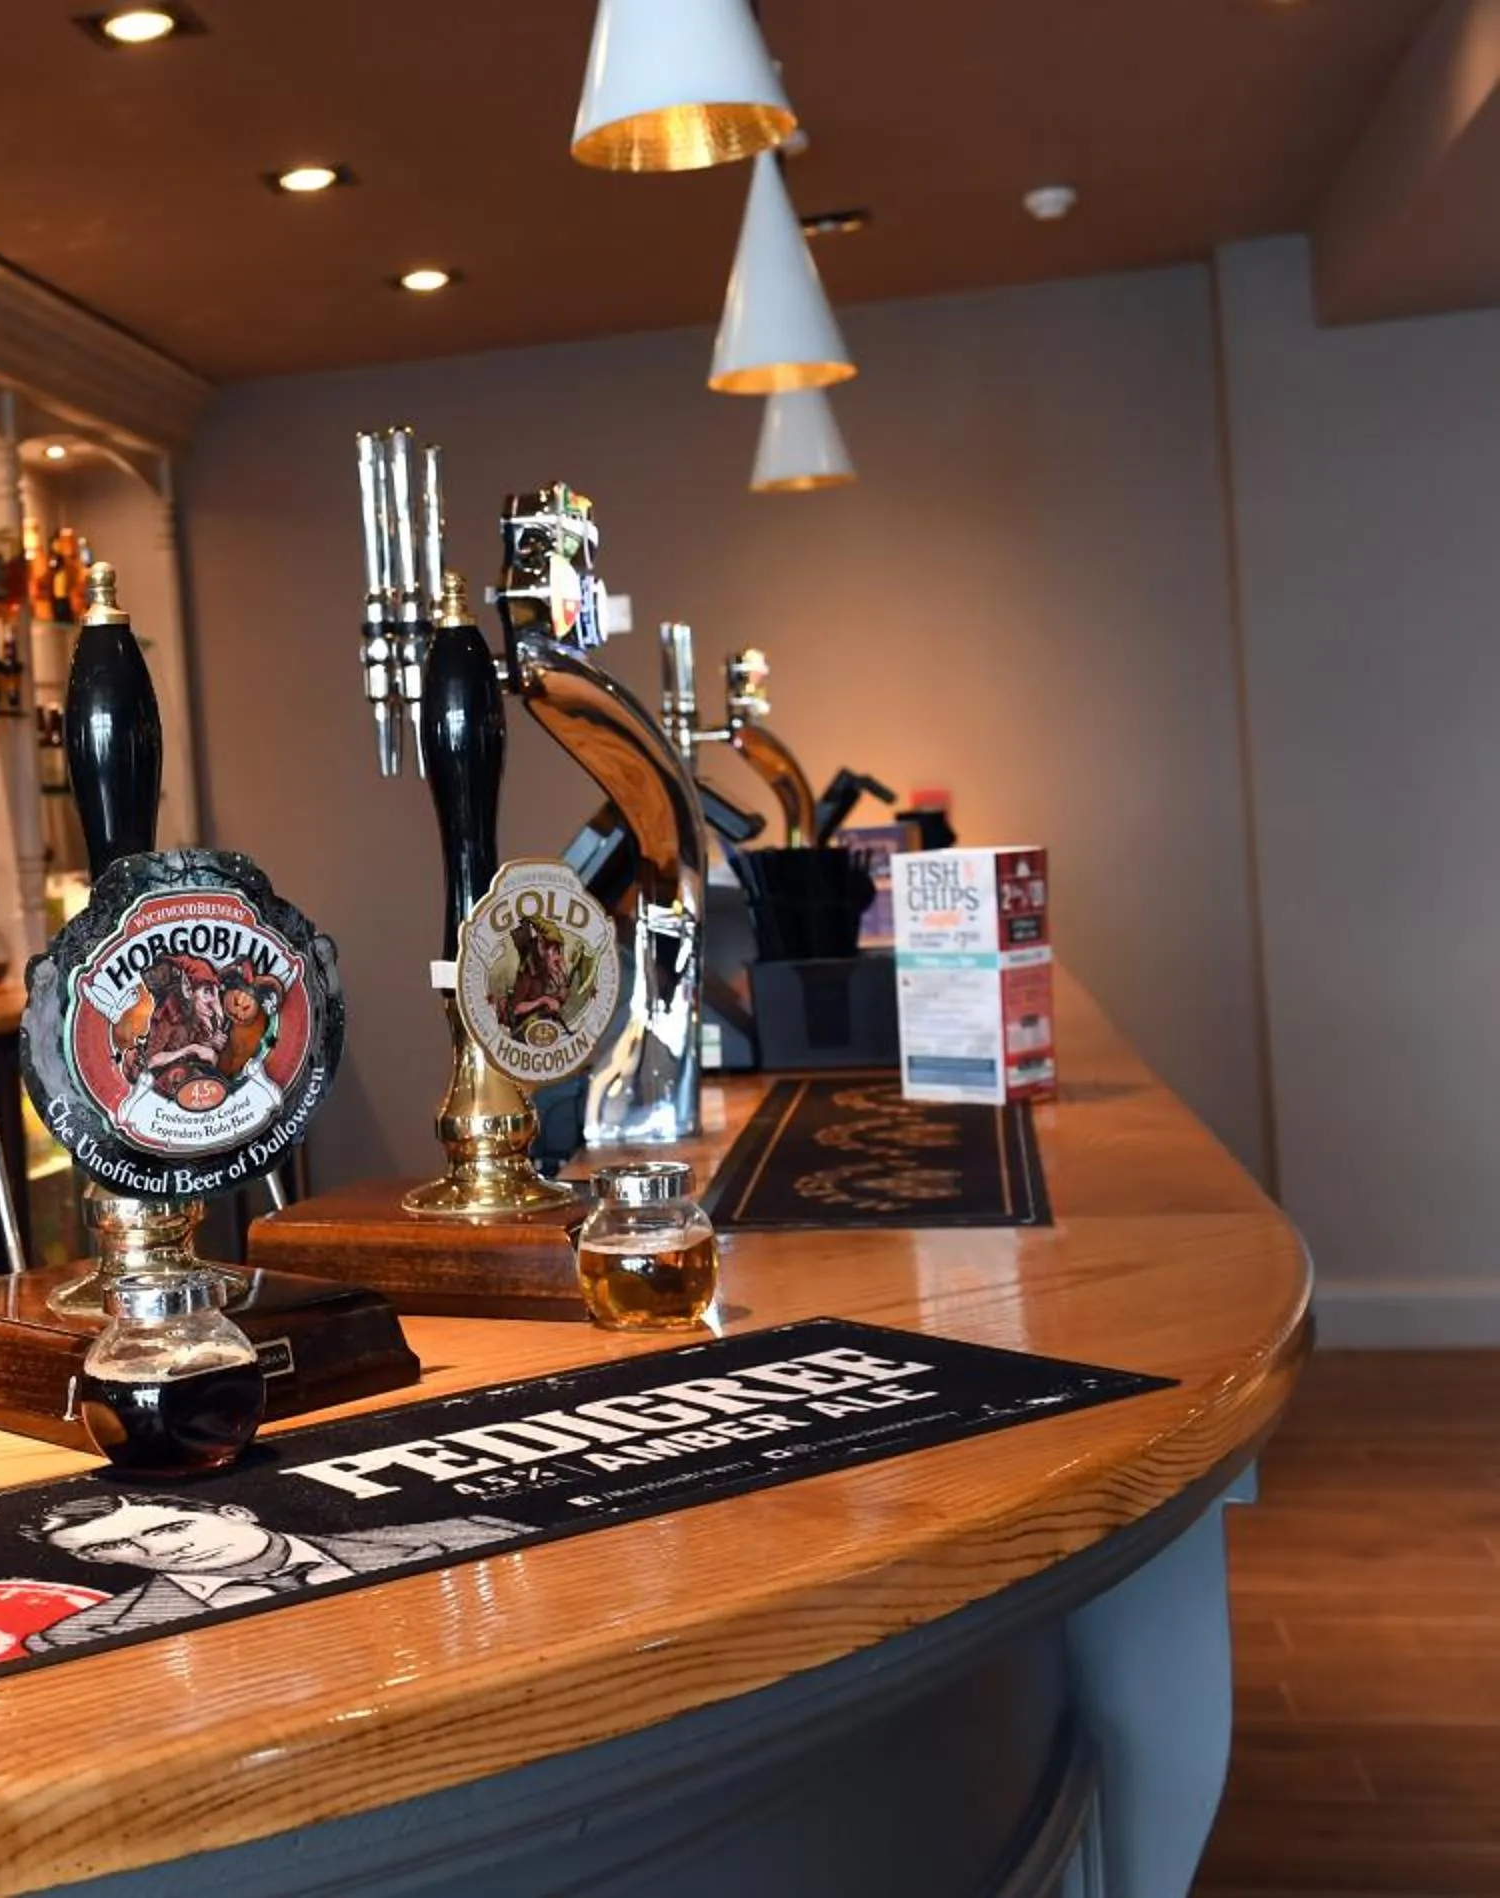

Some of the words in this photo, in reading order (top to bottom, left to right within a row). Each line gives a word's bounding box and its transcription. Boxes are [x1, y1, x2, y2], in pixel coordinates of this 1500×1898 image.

[906, 860, 960, 887] FISH
[907, 886, 980, 911] CHIPS
[490, 889, 590, 932] GOLD
[106, 924, 278, 990] HOBGOBLIN
[496, 1031, 590, 1073] HOBGOBLIN
[47, 1093, 76, 1140] The
[77, 1132, 169, 1193] Unofficial
[174, 1169, 224, 1194] Beer
[228, 1156, 248, 1180] of
[247, 1066, 325, 1166] Halloween
[278, 1346, 937, 1500] PEDIGREE
[581, 1412, 812, 1473] AMBER
[804, 1383, 940, 1419] ALE
